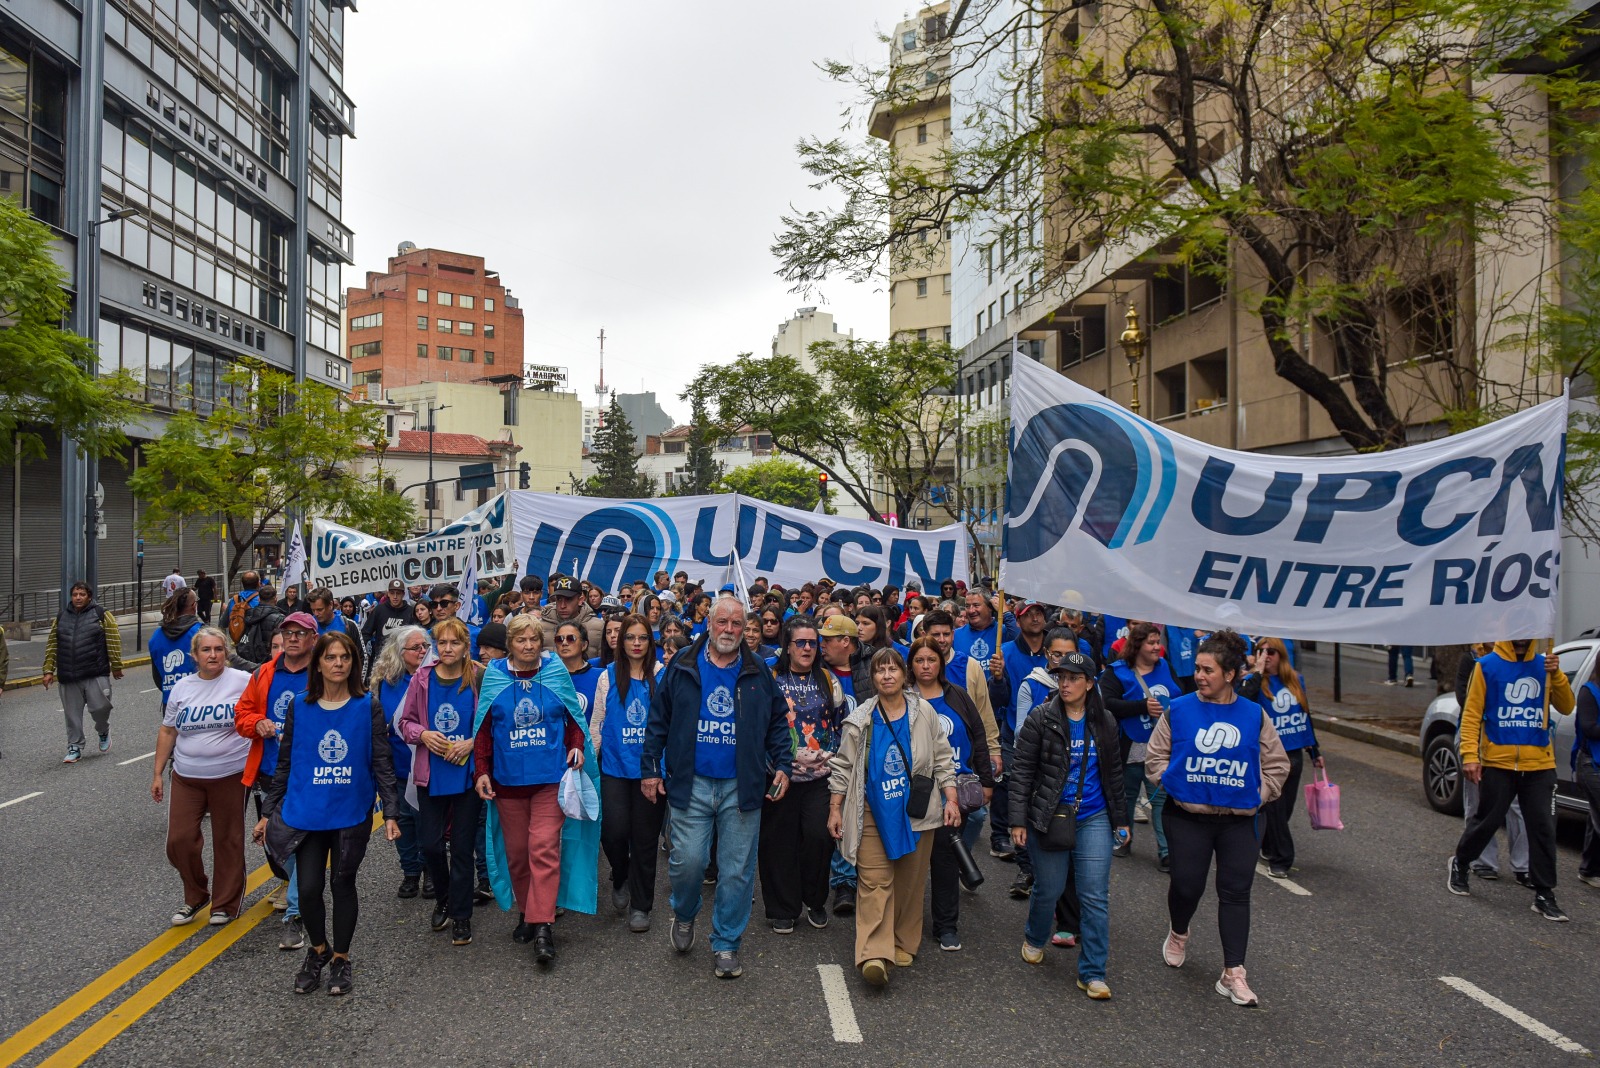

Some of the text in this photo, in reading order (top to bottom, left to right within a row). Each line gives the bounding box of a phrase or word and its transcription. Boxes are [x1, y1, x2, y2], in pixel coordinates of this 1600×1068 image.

[1191, 441, 1566, 547] UPCN
[339, 544, 411, 566] SECCIONAL
[417, 537, 466, 553] ENTRE
[692, 503, 956, 596] UPCN
[315, 561, 398, 589] DELEGACIÓN
[1188, 541, 1561, 608] ENTRE RÍOS
[385, 617, 404, 627] NIKE
[190, 703, 236, 723] UPCN
[1498, 719, 1544, 729] ENTRE RÍO
[509, 727, 546, 741] UPCN
[697, 733, 737, 745] Entre Río
[510, 740, 529, 749] Entre
[313, 766, 352, 777] UPCN
[1185, 756, 1249, 778] UPCN
[312, 777, 333, 785] Entre
[1186, 774, 1245, 788] ENTRE RÍOS
[884, 790, 903, 800] Entre
